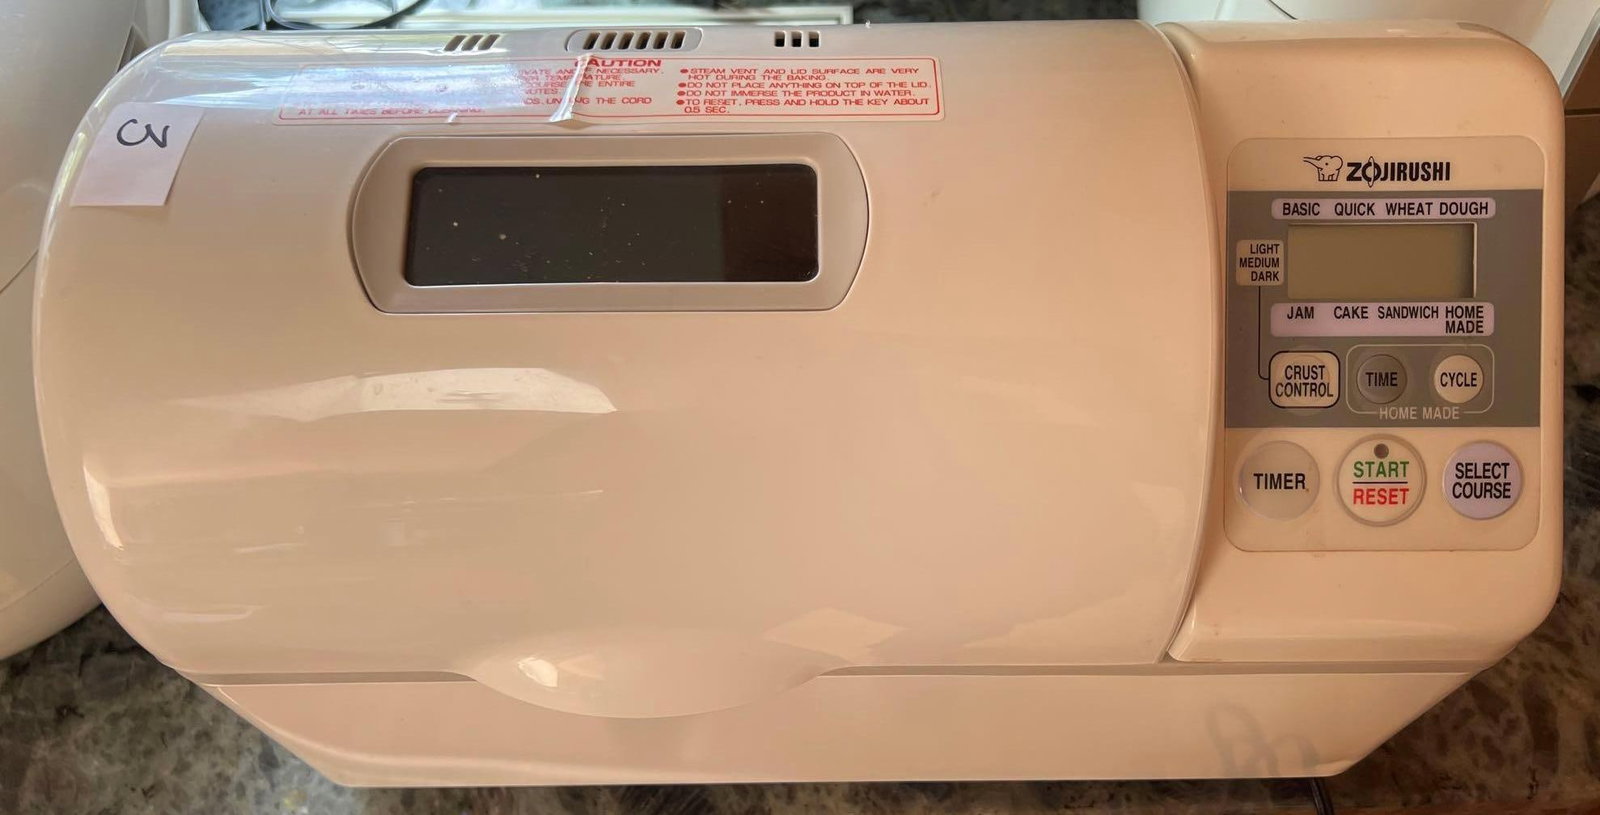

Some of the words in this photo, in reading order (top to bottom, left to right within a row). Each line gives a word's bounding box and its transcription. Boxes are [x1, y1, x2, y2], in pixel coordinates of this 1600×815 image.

[1346, 157, 1451, 188] ZOJIRUSHI
[1282, 203, 1321, 216] BASIC
[1334, 203, 1376, 216] QUICK
[1385, 203, 1433, 215] WHEAT
[1439, 202, 1489, 215] DOUGH
[1250, 244, 1280, 255] LIGHT
[1239, 257, 1280, 268] MEDIUM
[1250, 271, 1280, 282] DARK
[1287, 306, 1315, 319] JAM
[1333, 306, 1369, 319] CAKE
[1377, 306, 1439, 319] SANDWICH
[1445, 306, 1484, 318] HOME
[1445, 321, 1484, 334] MADE
[1284, 365, 1326, 380] CRUST
[1365, 372, 1398, 387] TIME
[1440, 372, 1478, 387] CYCLE
[1275, 382, 1334, 397] CONTROL
[1378, 406, 1418, 420] HOME
[1422, 406, 1460, 419] MADE
[1352, 461, 1410, 478] START
[1455, 462, 1510, 480] SELECT
[1253, 473, 1306, 490] TIMER
[1352, 488, 1410, 505] RESET
[1452, 482, 1511, 499] COURSE
